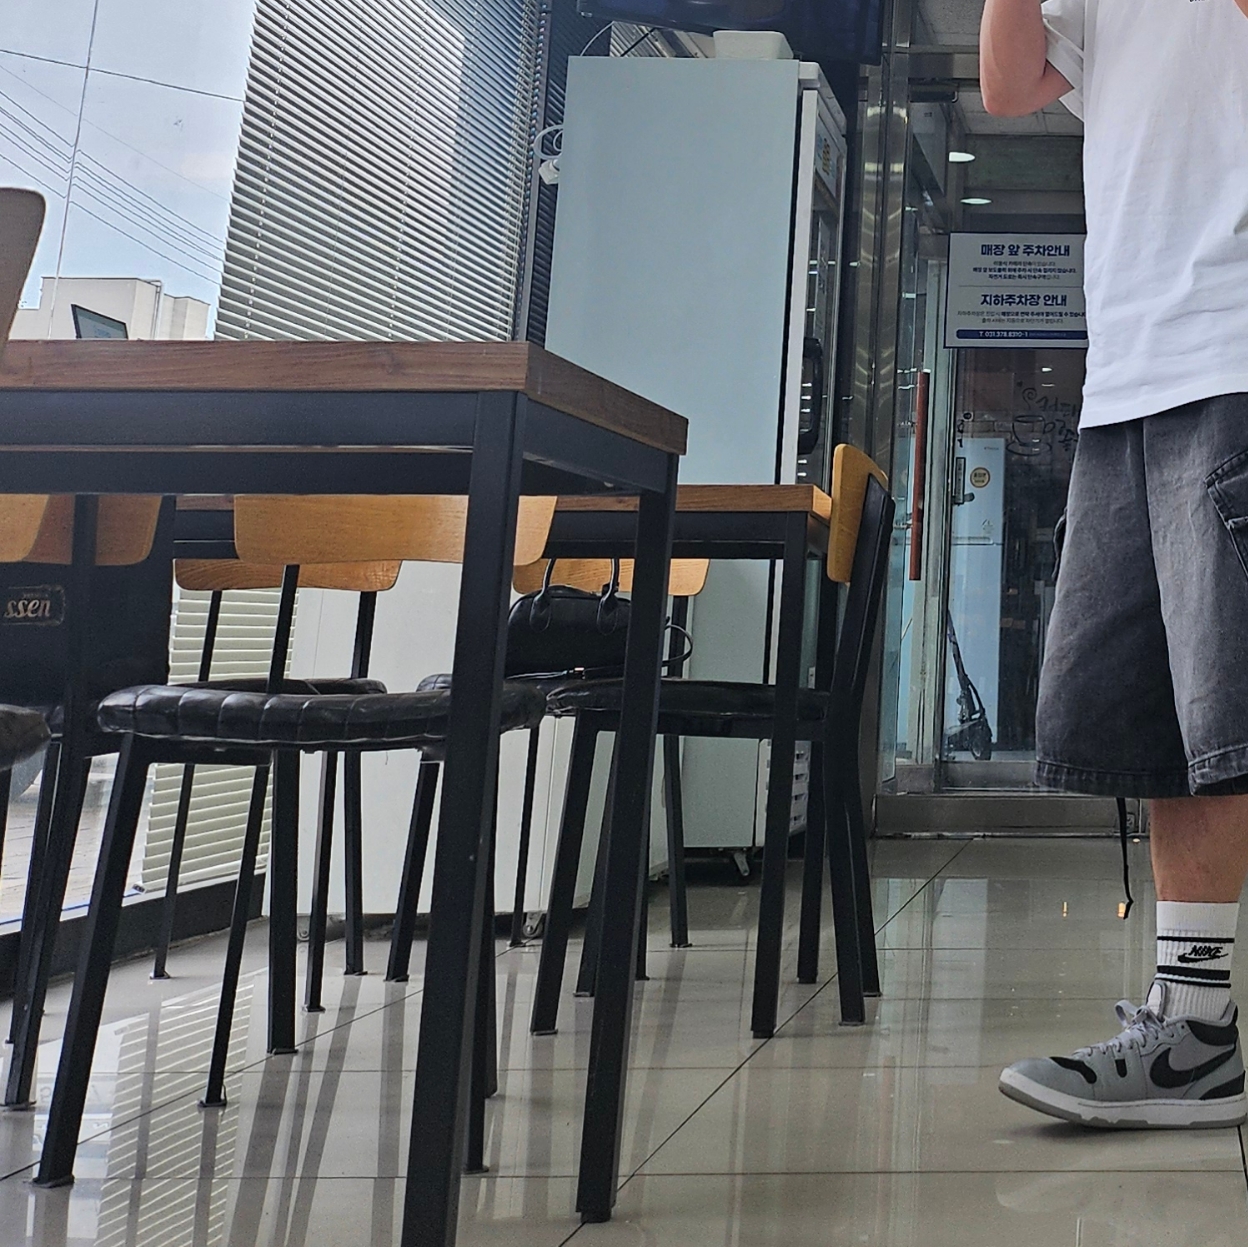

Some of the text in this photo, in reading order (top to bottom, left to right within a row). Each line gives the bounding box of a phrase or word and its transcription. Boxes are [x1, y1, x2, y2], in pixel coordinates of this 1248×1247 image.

[980, 243, 1071, 257] 매장 앞 주차안내
[980, 293, 1068, 307] 지하주차장 안내
[1188, 944, 1223, 957] NIKE
